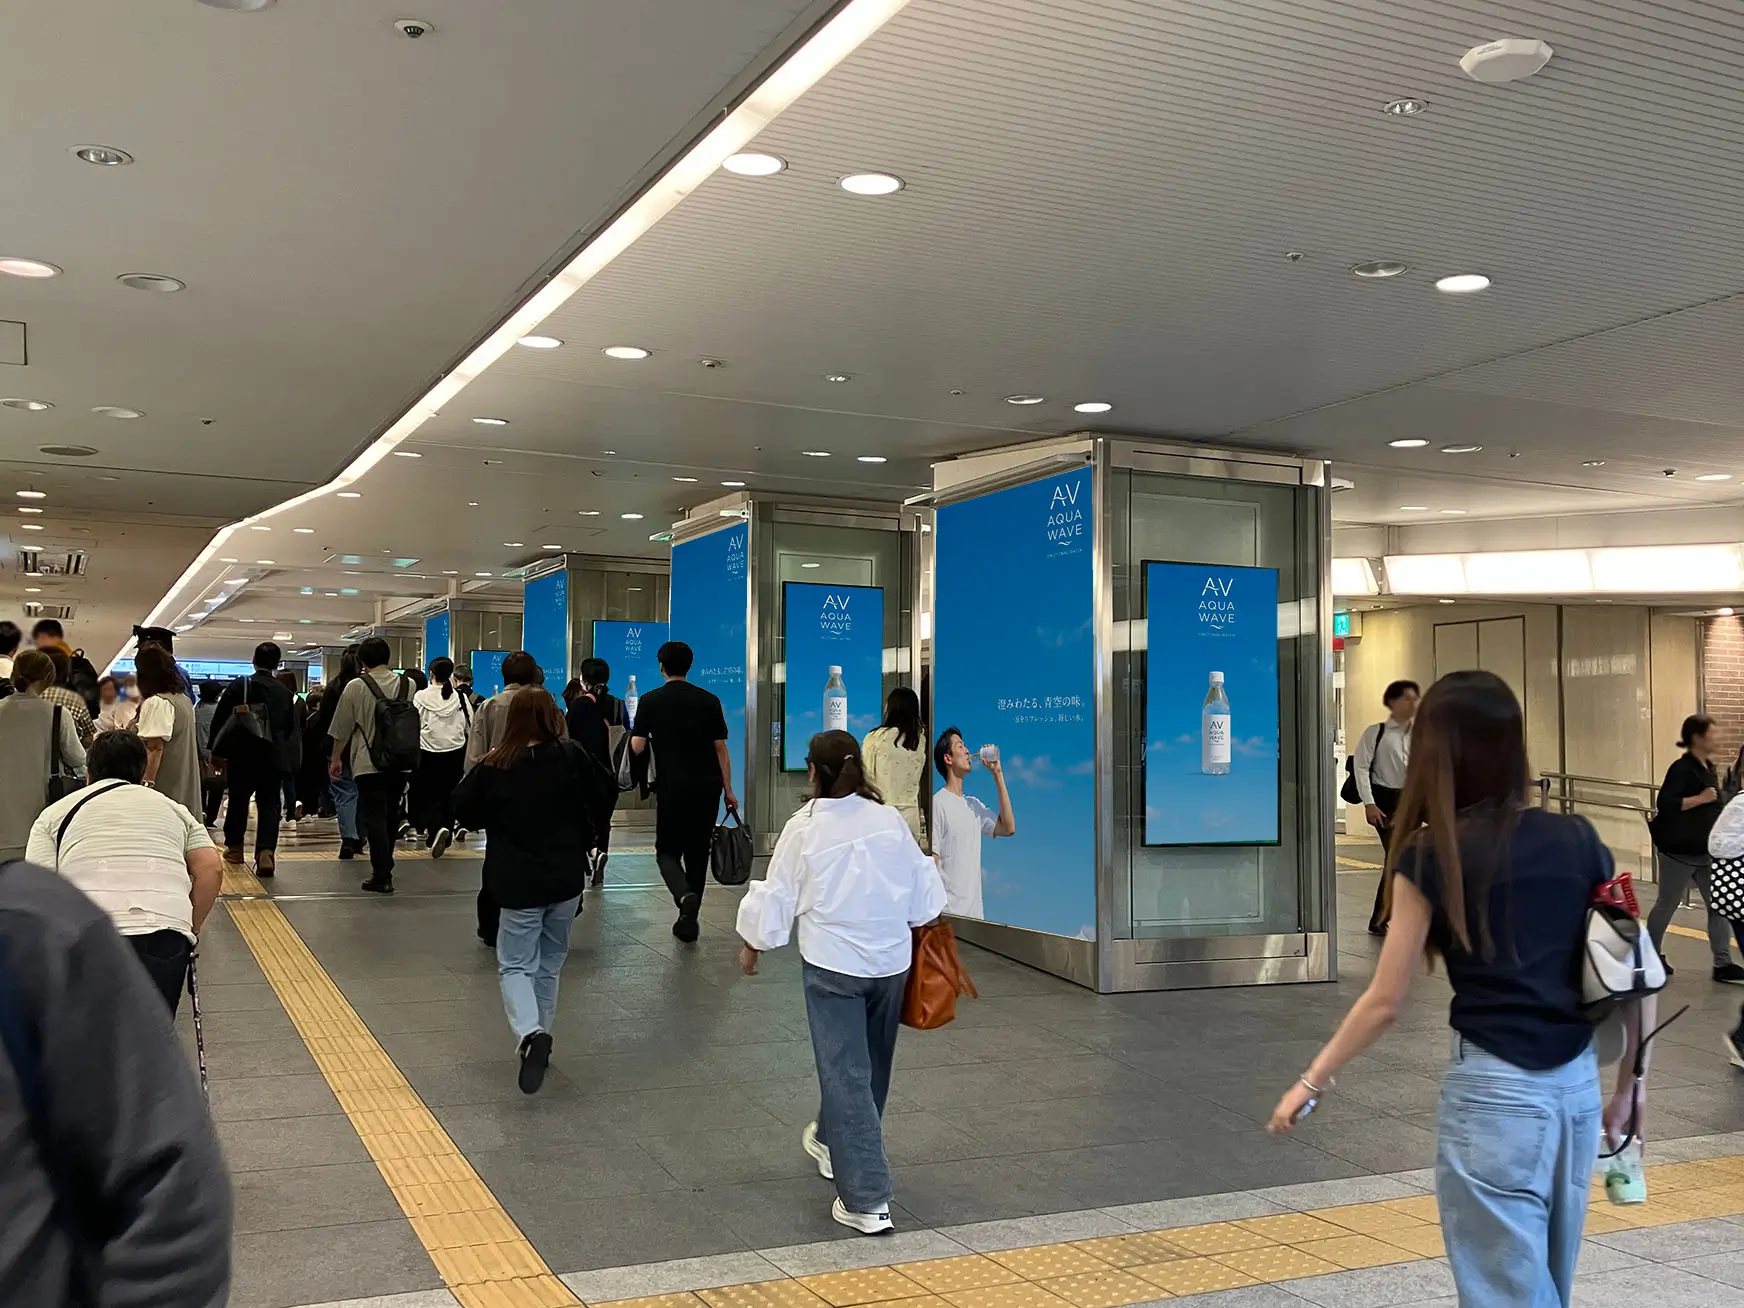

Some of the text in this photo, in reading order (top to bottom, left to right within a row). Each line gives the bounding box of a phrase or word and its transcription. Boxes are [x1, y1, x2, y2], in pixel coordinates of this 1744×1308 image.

[1050, 480, 1081, 510] AV
[1047, 509, 1083, 527] AQUA
[1047, 523, 1083, 541] WAVE
[728, 533, 744, 552] AV
[1201, 577, 1234, 597] AV
[823, 594, 851, 610] AV
[1198, 600, 1235, 611] AQUA
[820, 612, 852, 621] AQUA
[1198, 612, 1236, 624] WAVE
[626, 627, 642, 639] AV
[820, 621, 852, 631] WAVE
[1209, 720, 1224, 730] AV
